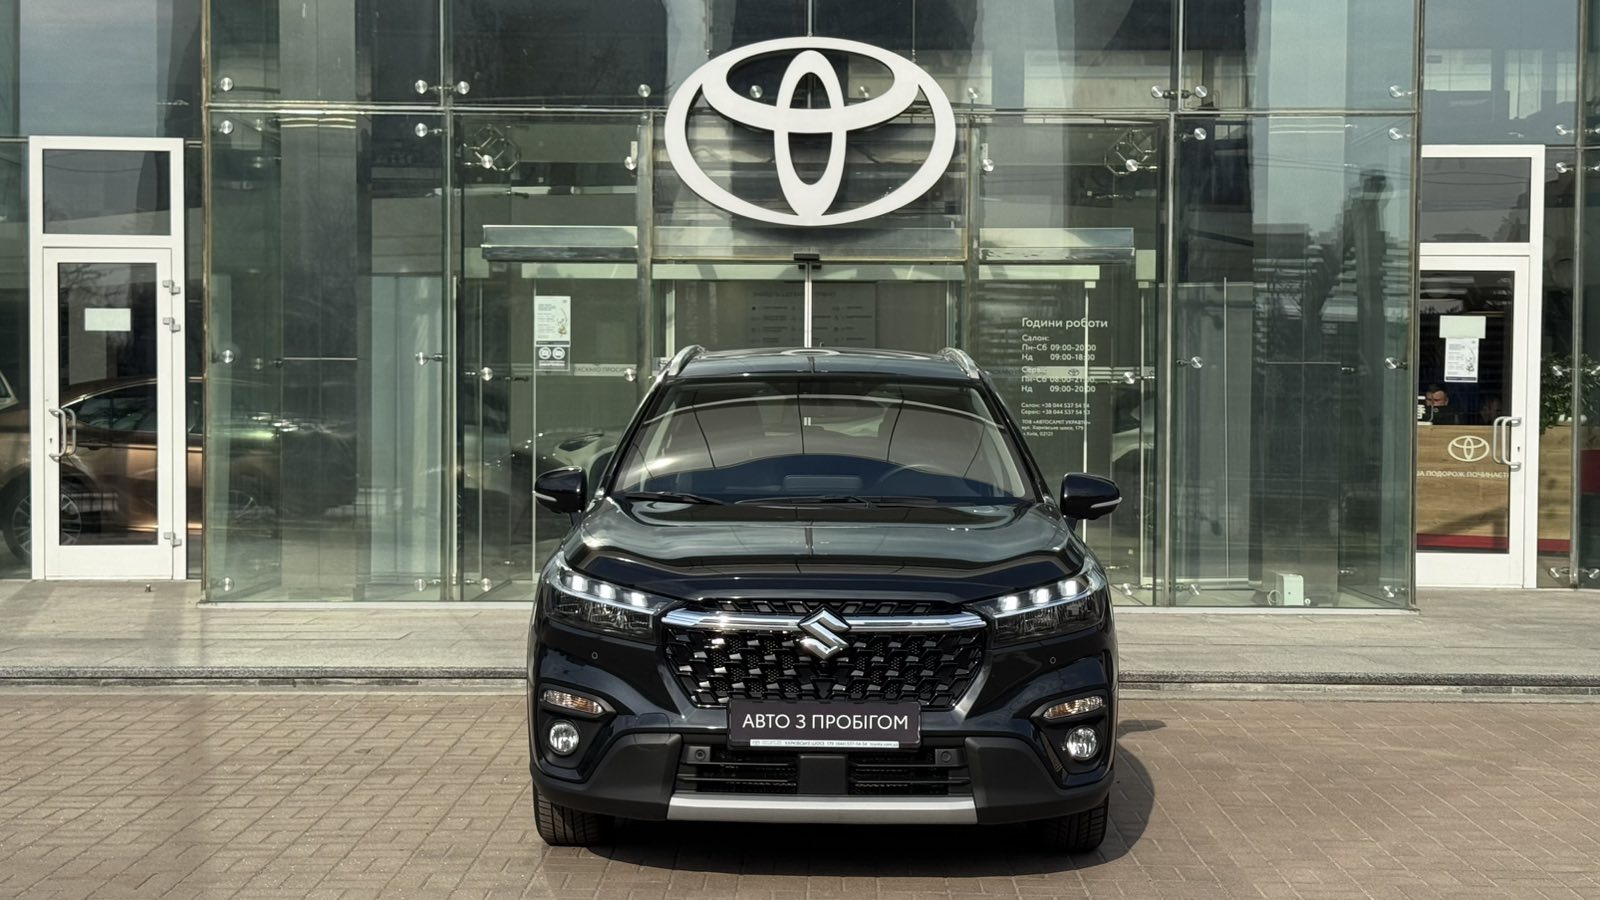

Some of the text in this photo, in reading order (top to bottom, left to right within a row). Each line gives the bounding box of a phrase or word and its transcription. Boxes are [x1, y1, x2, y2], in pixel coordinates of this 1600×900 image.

[1022, 317, 1108, 330] Години роботи
[1021, 334, 1049, 342] Салон:
[1021, 343, 1097, 351] Пн-Сб 09:00-2000
[1021, 353, 1034, 361] Нд
[1021, 385, 1096, 393] Нд 09:00-2000
[1426, 470, 1465, 478] ПОДОРОЖ
[742, 713, 909, 730] АВТО З ПРОБІГОМ
